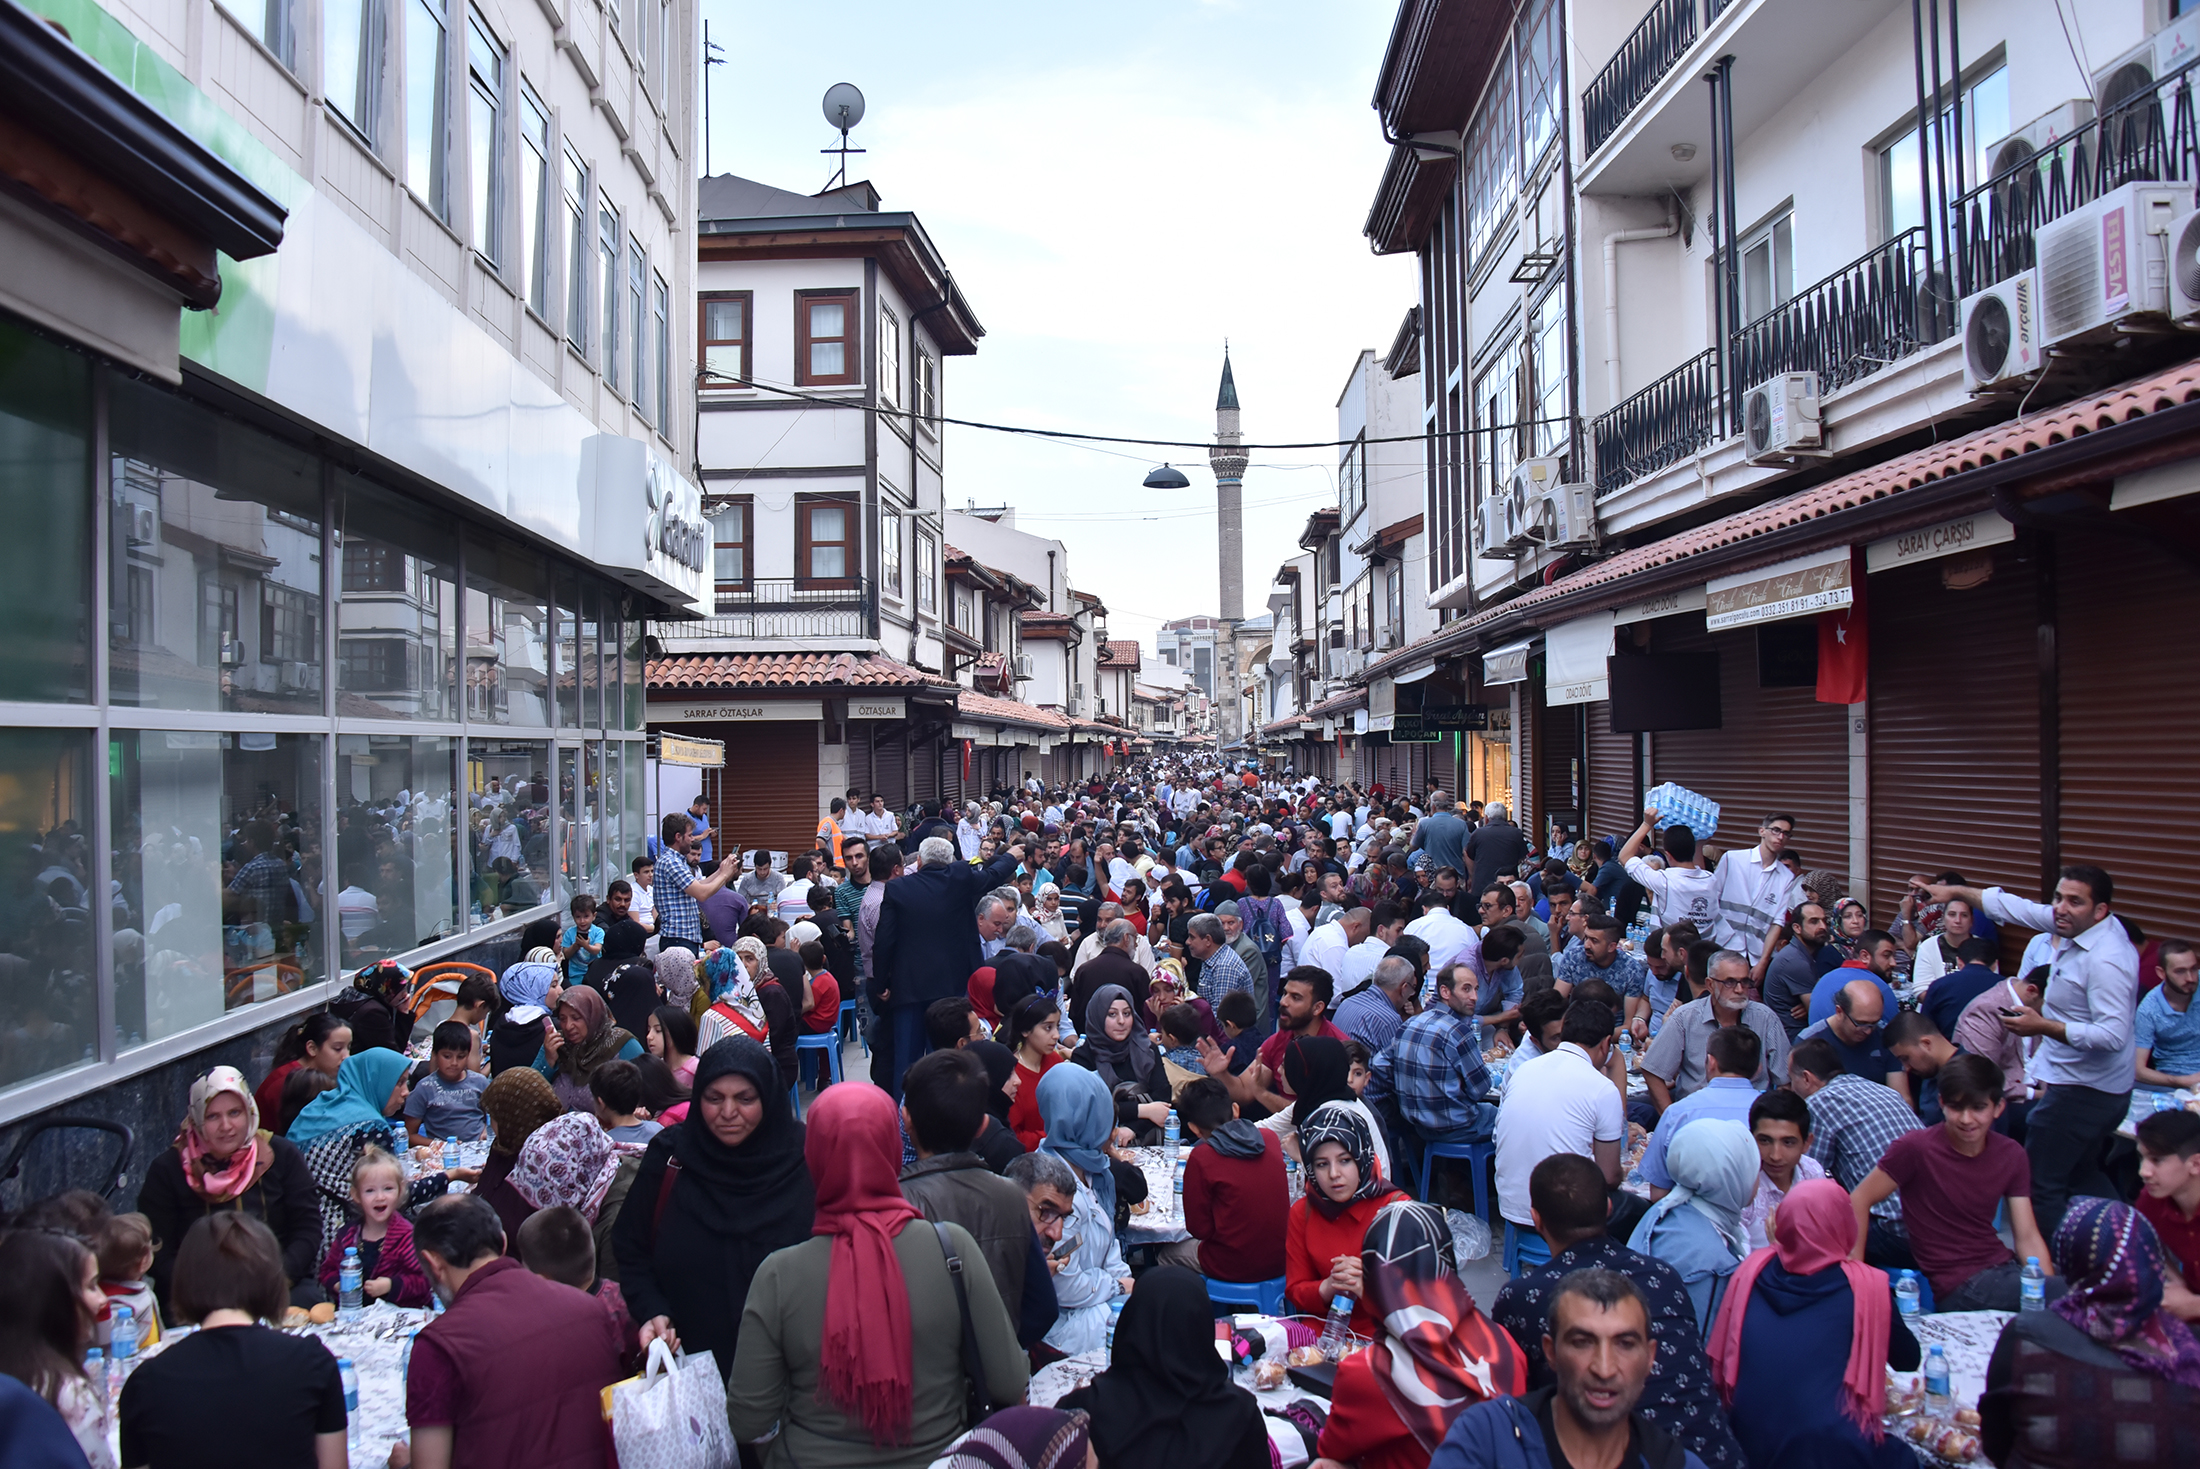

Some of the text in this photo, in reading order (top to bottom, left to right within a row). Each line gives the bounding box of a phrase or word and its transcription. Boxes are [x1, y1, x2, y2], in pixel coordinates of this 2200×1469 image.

[2107, 208, 2124, 299] VESTEL
[2017, 282, 2030, 344] arçelik
[1897, 520, 1974, 557] SARAY ÇARŞISI
[1642, 600, 1660, 615] ODACI
[1761, 602, 1789, 617] 0332.351
[1791, 600, 1799, 611] 81
[1800, 598, 1809, 609] 91
[1815, 594, 1827, 607] 352
[1829, 591, 1839, 603] 73
[1841, 589, 1849, 601] 77
[1565, 688, 1578, 699] ODACI
[683, 707, 763, 719] SARRAF ÖZTAŞLAR
[858, 705, 897, 716] ÖZTAŞLAR
